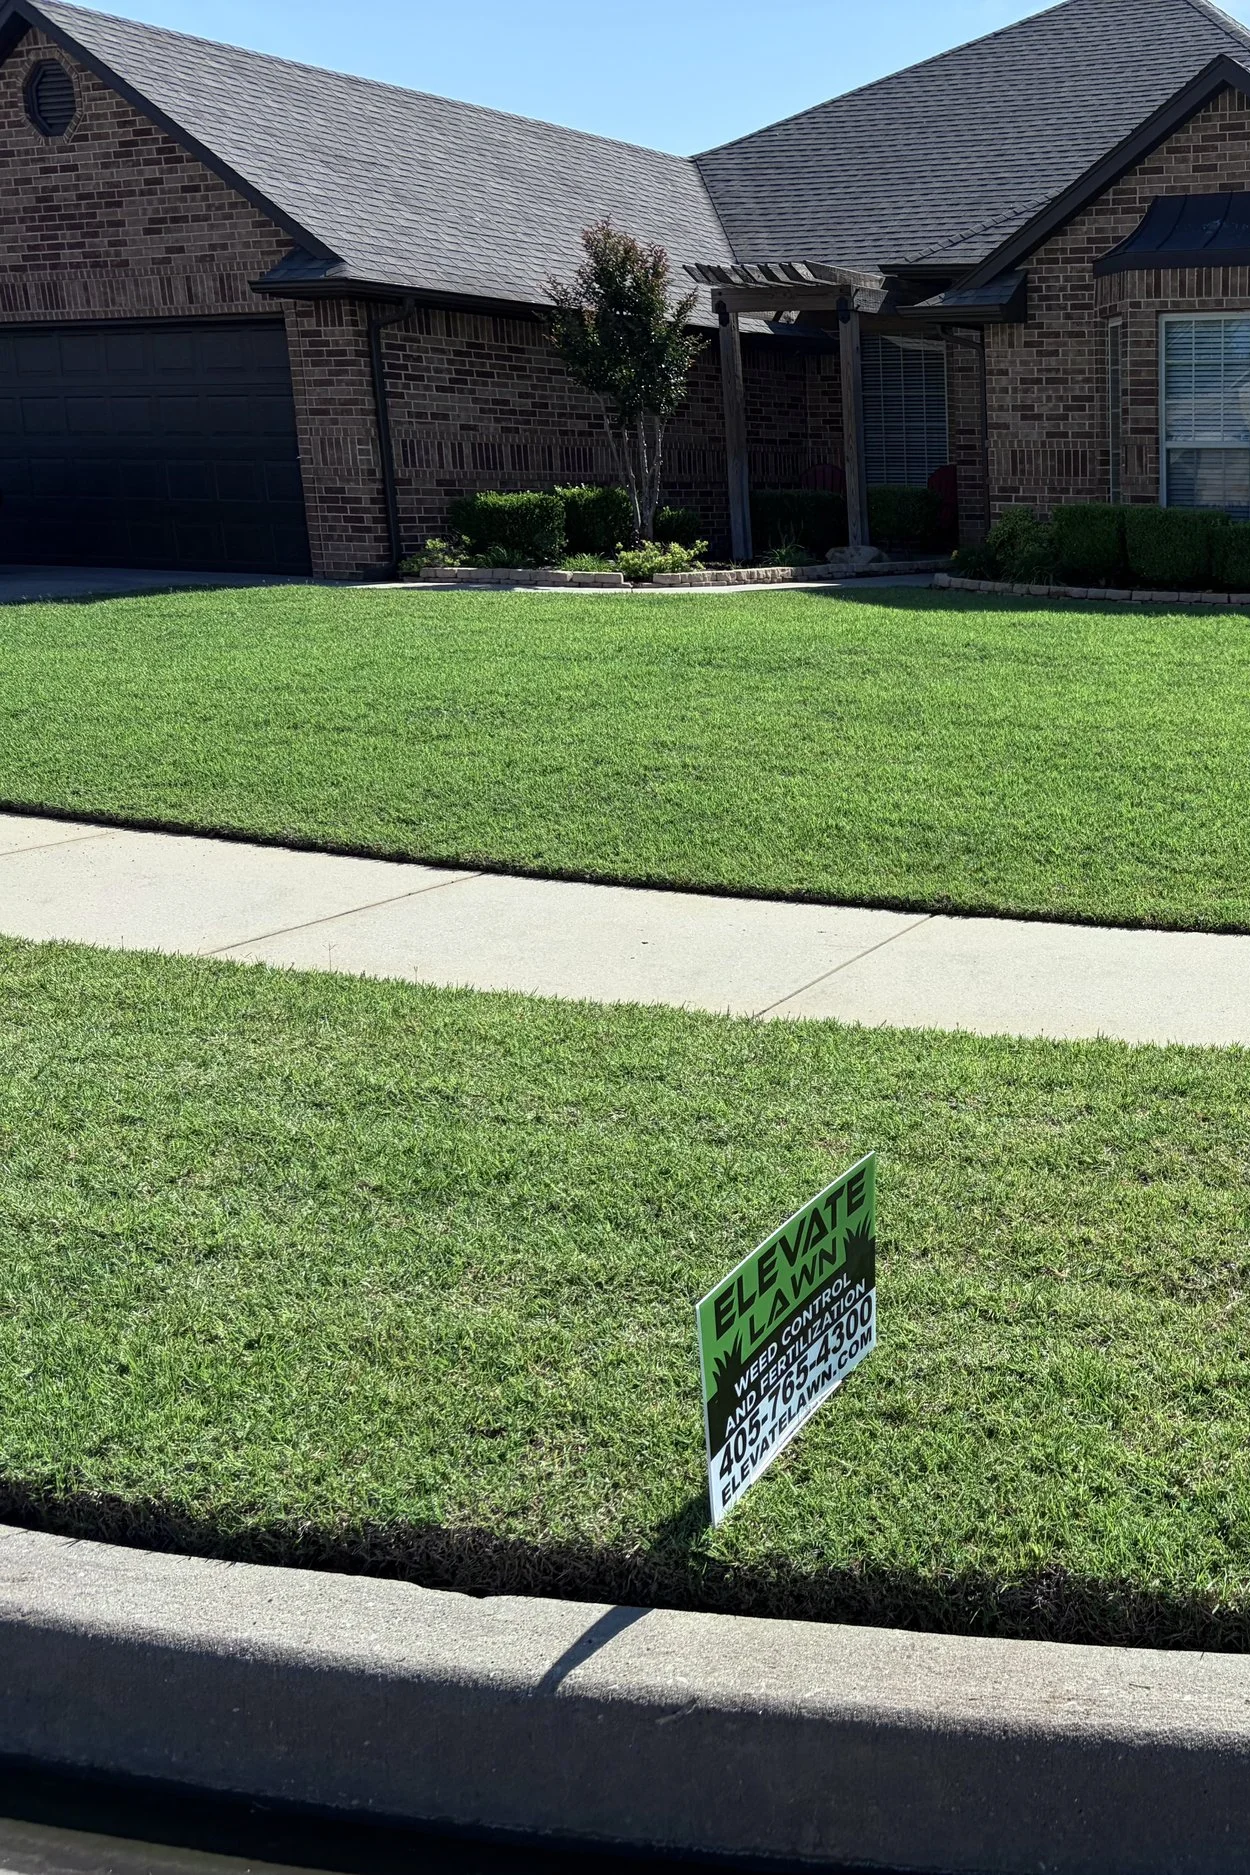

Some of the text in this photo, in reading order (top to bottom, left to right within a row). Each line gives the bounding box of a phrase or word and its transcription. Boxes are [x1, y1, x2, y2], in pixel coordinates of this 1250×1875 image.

[714, 1168, 866, 1341] ELEVATE
[734, 1272, 851, 1397] WEED CONTROL
[749, 1237, 837, 1345] LAWN
[719, 1296, 872, 1481] 405-765-4300
[721, 1326, 873, 1507] ELEVATELAWN.COM
[725, 1278, 866, 1438] AND FERTILIZATION
